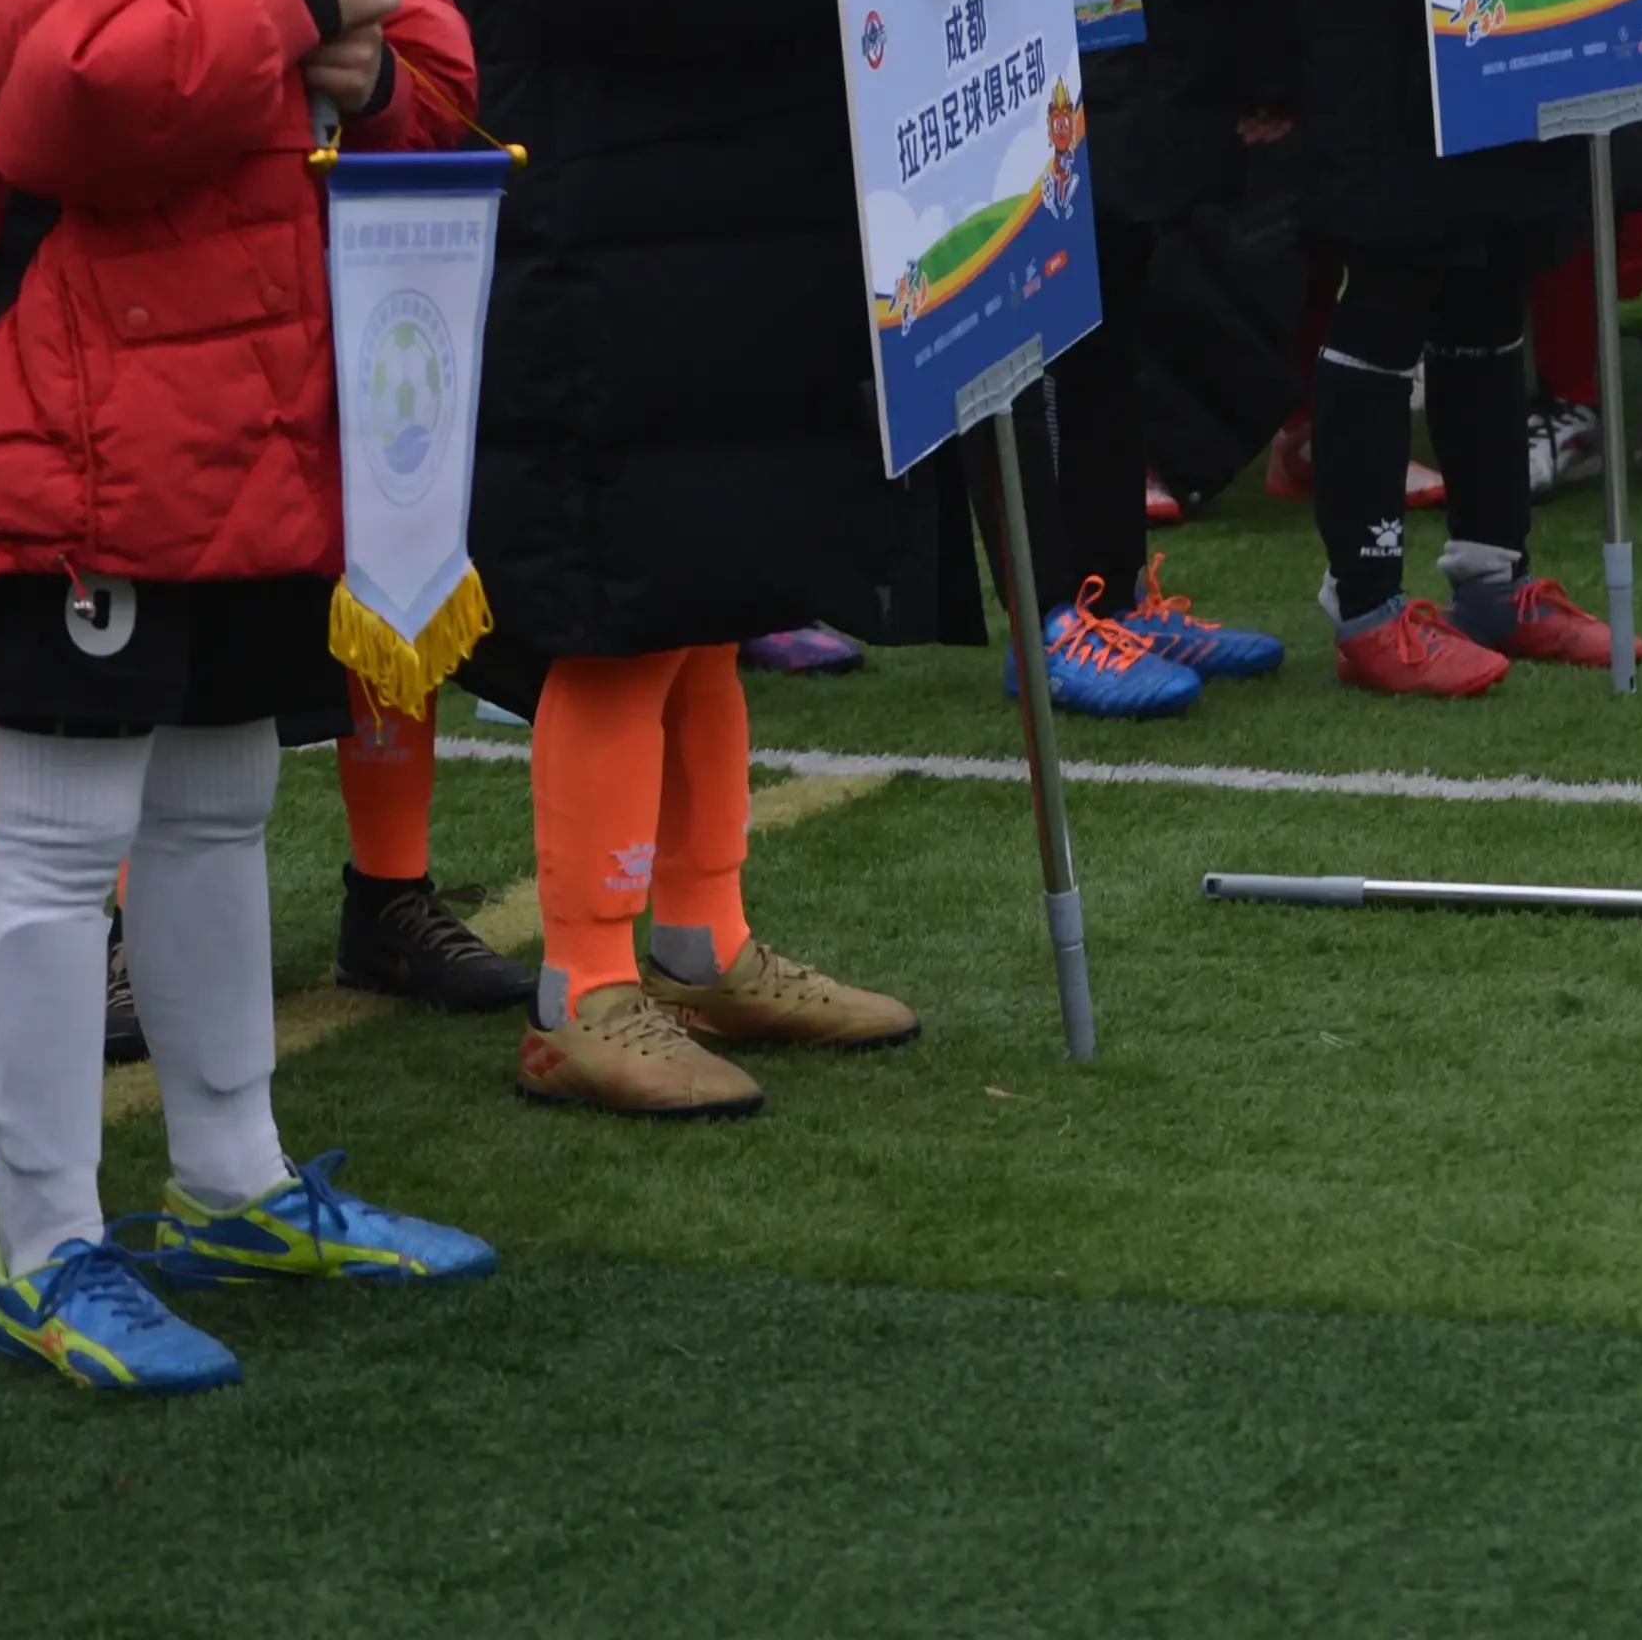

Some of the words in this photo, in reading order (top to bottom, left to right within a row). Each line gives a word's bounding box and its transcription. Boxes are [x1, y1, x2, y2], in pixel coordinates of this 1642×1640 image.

[897, 37, 1047, 185] 拉玛足球俱乐部
